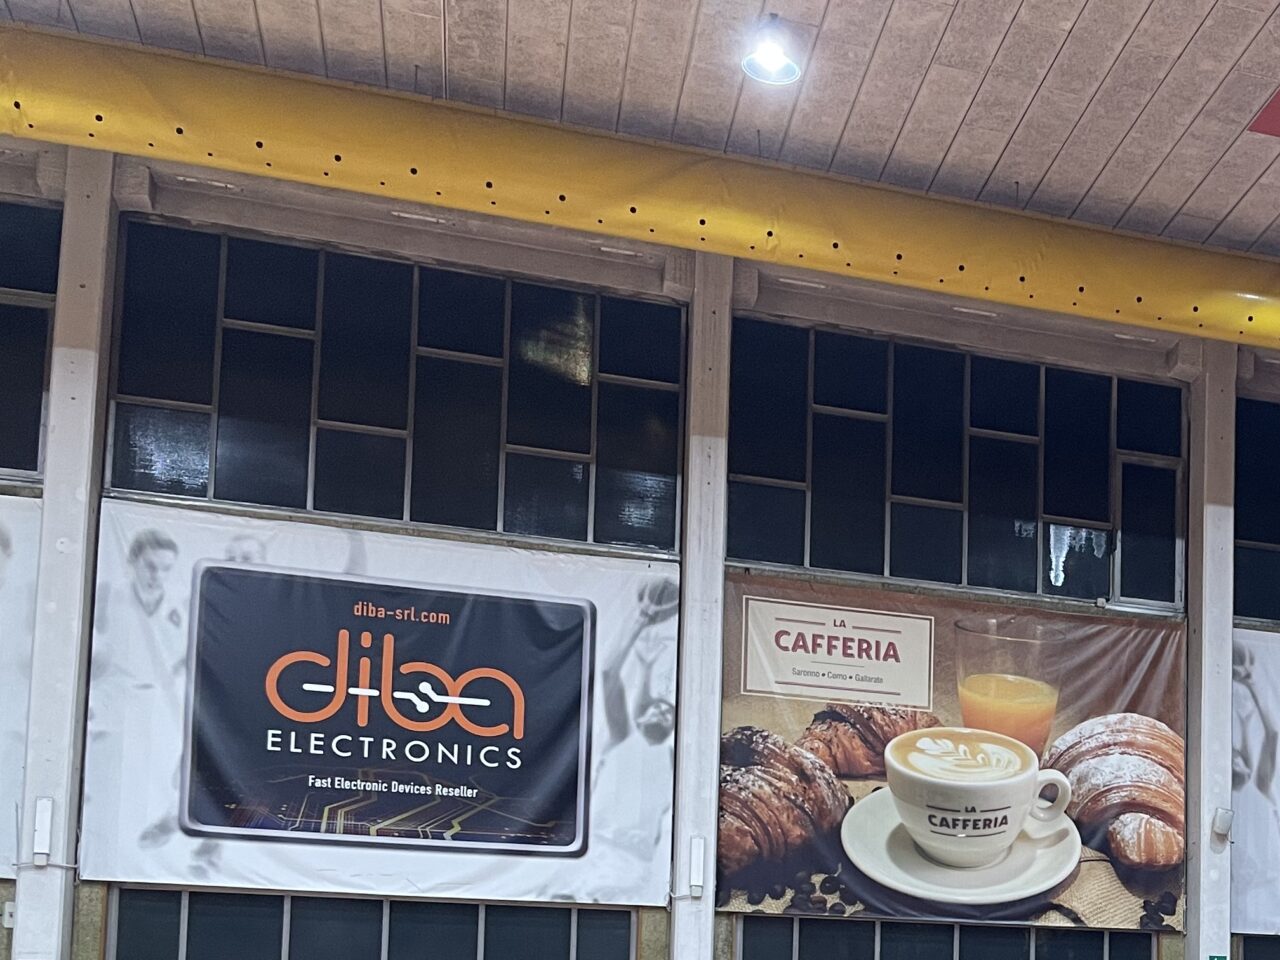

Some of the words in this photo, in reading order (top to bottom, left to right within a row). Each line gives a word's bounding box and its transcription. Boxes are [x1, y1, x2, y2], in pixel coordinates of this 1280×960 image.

[353, 601, 450, 625] diba-srl.com
[833, 619, 847, 628] LA
[774, 630, 901, 663] CAFFERIA
[265, 628, 525, 740] diba
[792, 667, 820, 678] Saronno
[827, 671, 847, 681] Como
[266, 729, 523, 769] ELECTRONICS
[308, 775, 332, 789] Fast
[335, 777, 388, 792] Electronic
[391, 782, 432, 795] Devices
[435, 784, 479, 798] Reseller
[927, 813, 1009, 831] CAFFERIA
